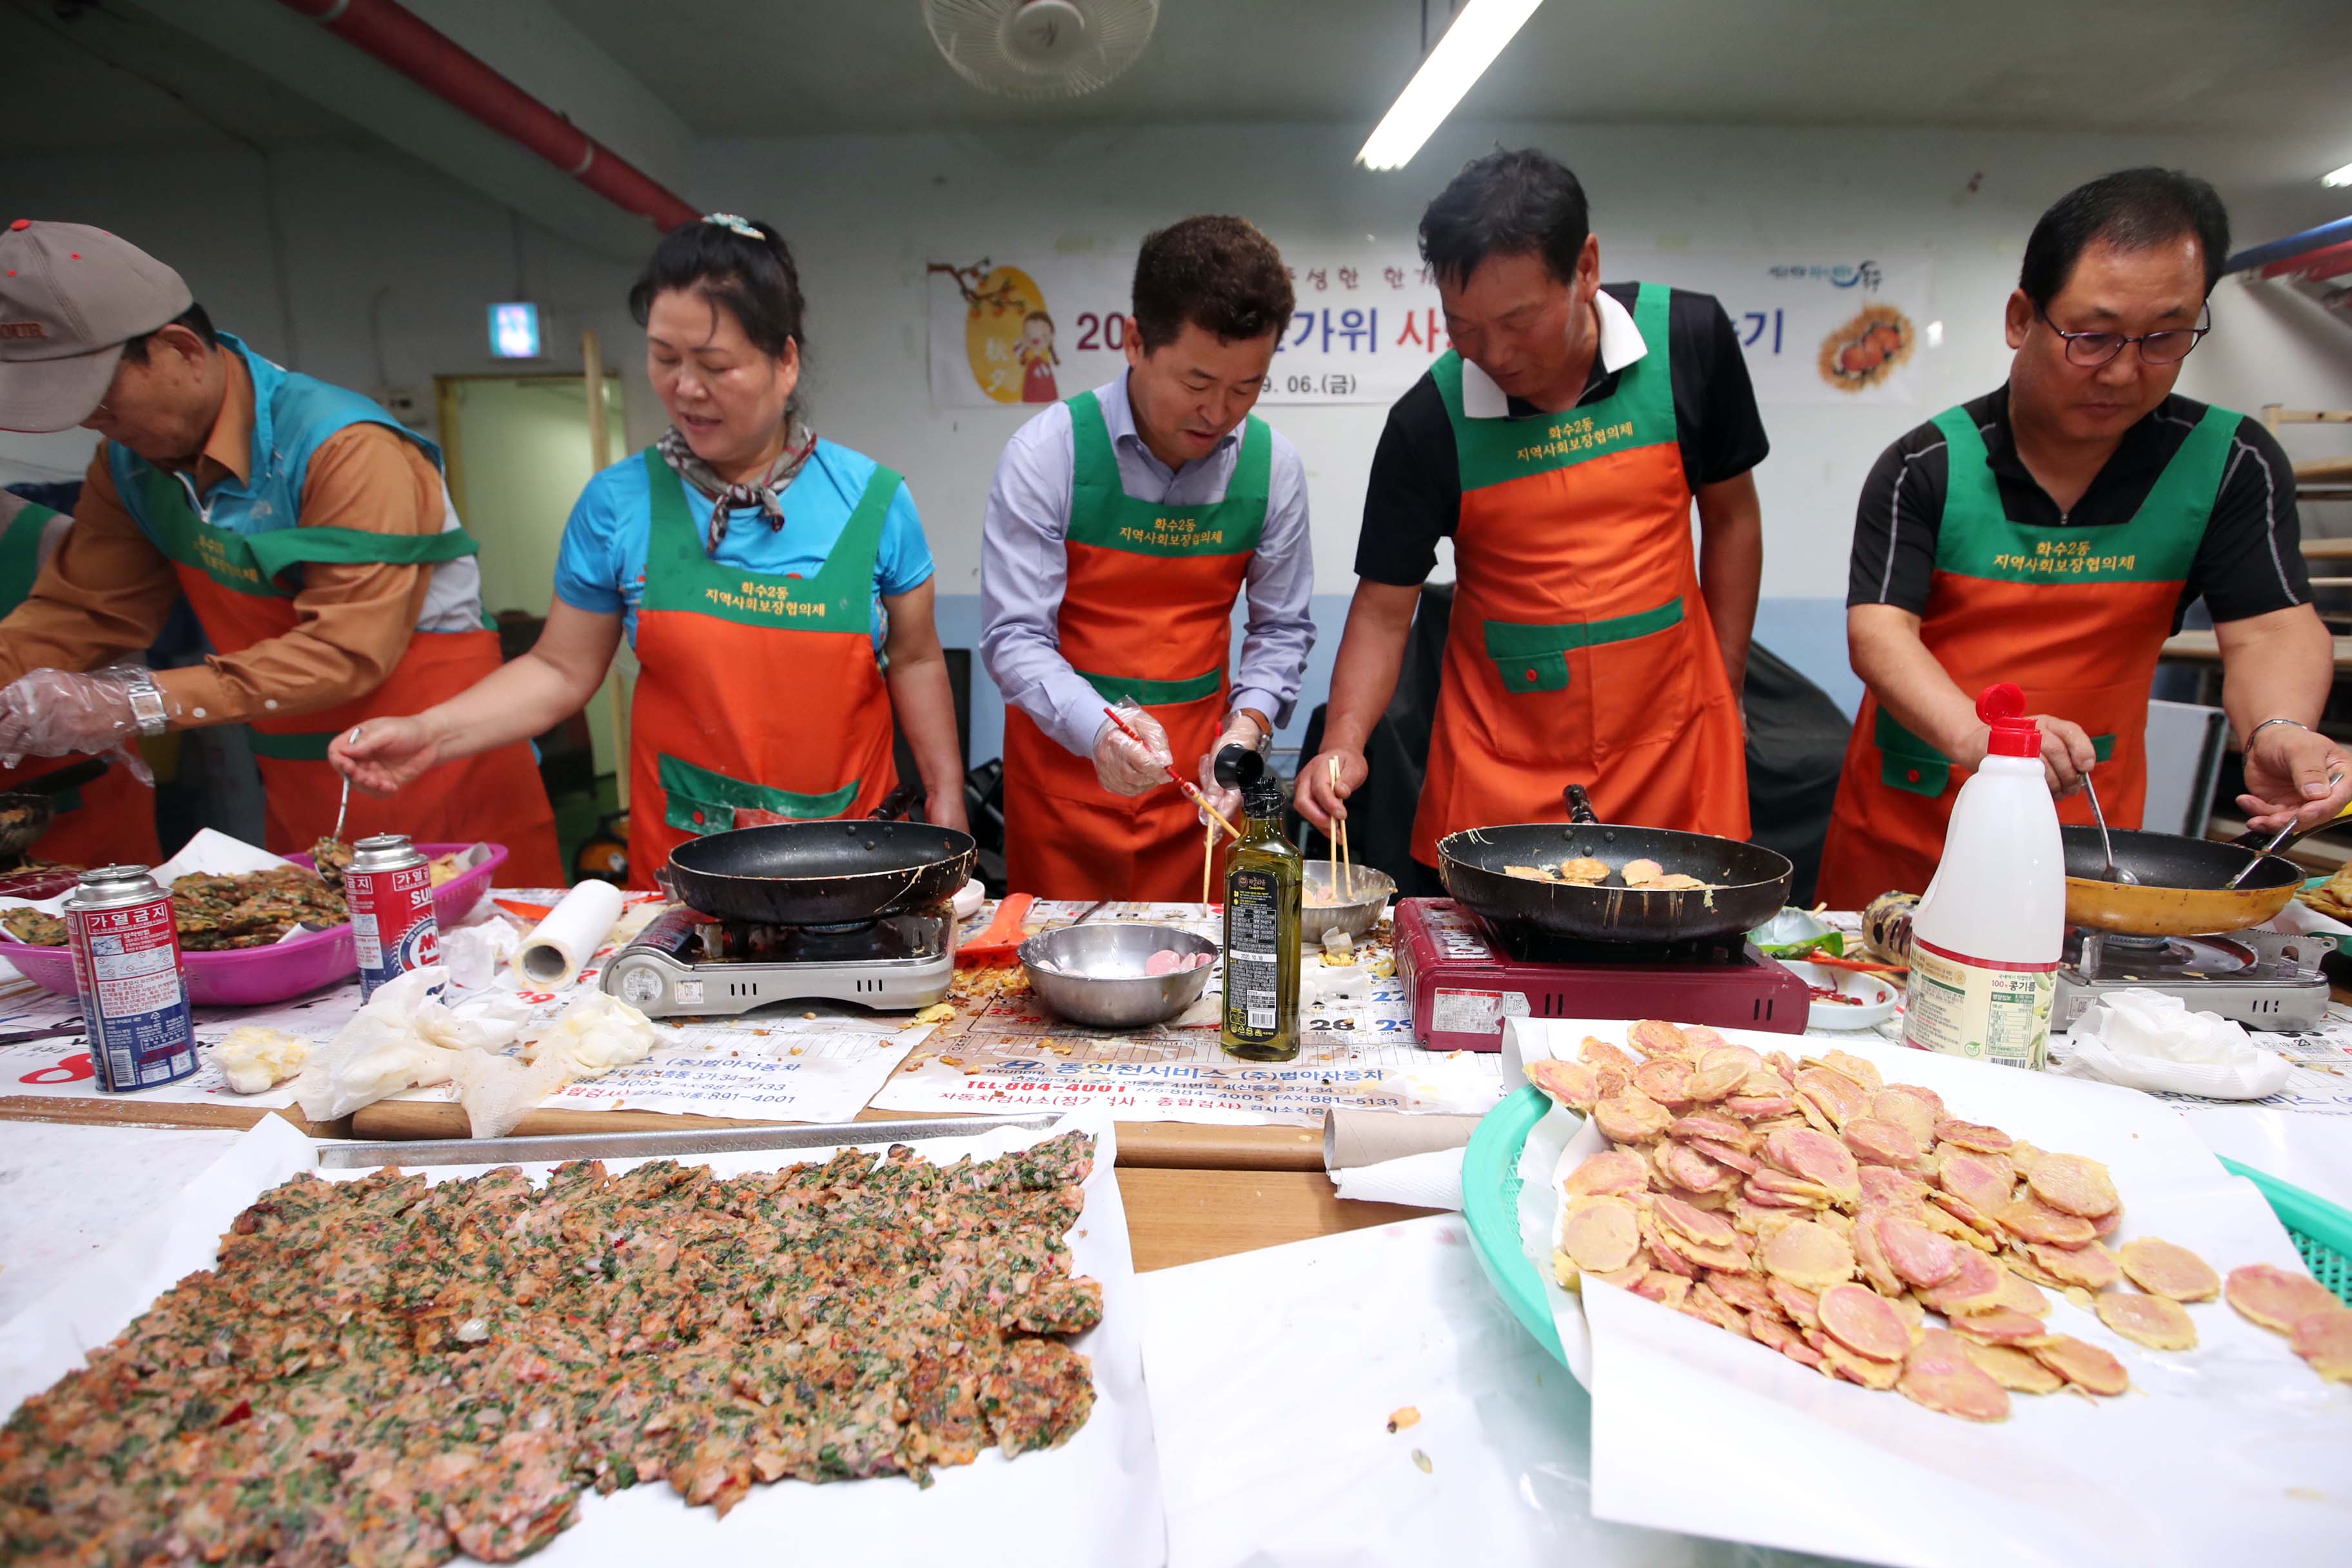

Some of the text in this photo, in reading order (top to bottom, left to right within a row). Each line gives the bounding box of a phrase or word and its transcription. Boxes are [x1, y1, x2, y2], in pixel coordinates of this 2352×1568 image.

[1289, 266, 1359, 291] 성한
[1276, 307, 1378, 353] 가위
[1396, 307, 1455, 353] 사
[1733, 308, 1784, 355] 기
[1287, 374, 1357, 395] 06.(금)
[1548, 416, 1594, 439] 화수2동
[1516, 421, 1634, 462] 지역사회보장협의체
[1154, 517, 1197, 532] 화수2동
[1119, 526, 1223, 547] 지역사회보장협의체
[2035, 540, 2091, 557] 화수2동
[1994, 554, 2135, 574] 지역사회보장협의체
[741, 581, 789, 600] 화수2동
[705, 588, 827, 617] 지역사회보장협의체
[90, 904, 166, 928] 가열금지
[2008, 981, 2037, 992] 콩기름
[988, 1008, 1016, 1016] 23
[1309, 1019, 1355, 1031] 28
[665, 1057, 802, 1072] (주)범아자동차
[1055, 1062, 1384, 1082] 동인천서비스 (주)범아자동차
[1275, 1094, 1399, 1106] FAX:881-5133
[1286, 1086, 1311, 1094] 3가
